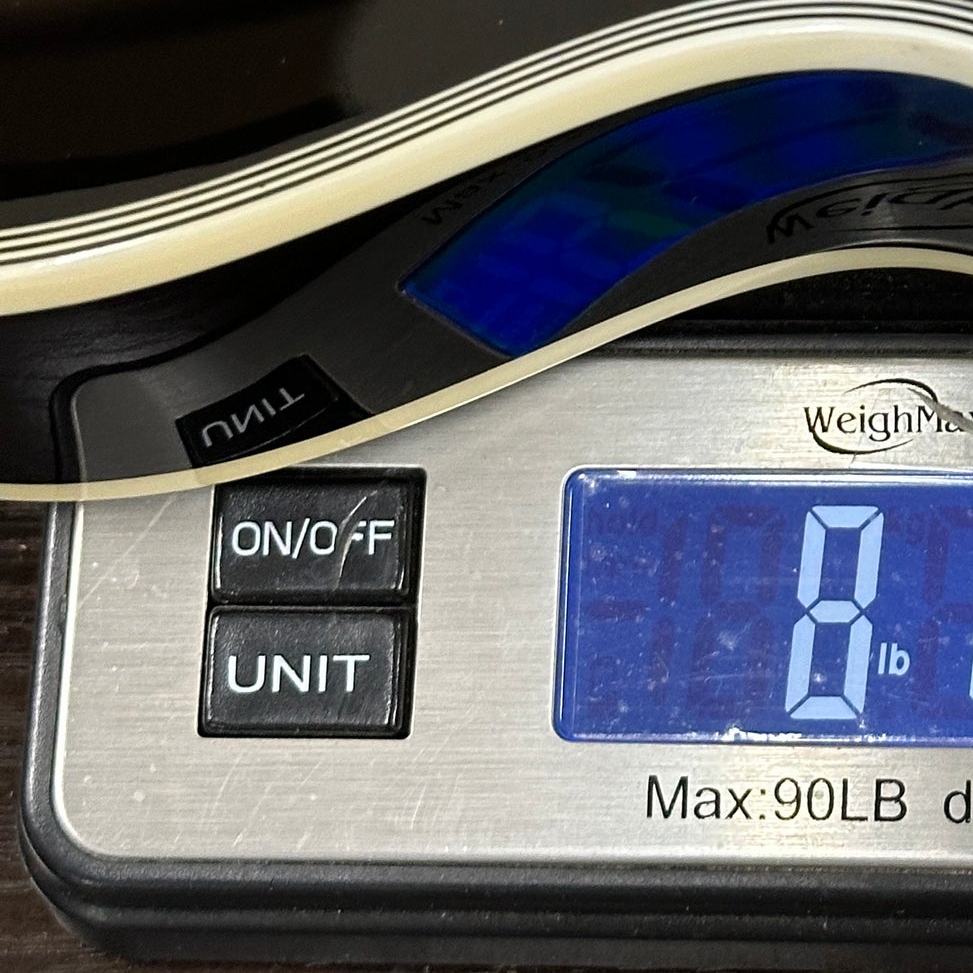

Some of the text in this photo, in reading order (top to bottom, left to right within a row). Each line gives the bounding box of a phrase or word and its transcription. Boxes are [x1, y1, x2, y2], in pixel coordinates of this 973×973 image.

[785, 505, 884, 720] 8
[878, 644, 910, 676] lb
[228, 654, 370, 693] UNIT
[646, 775, 907, 822] Max:90LB
